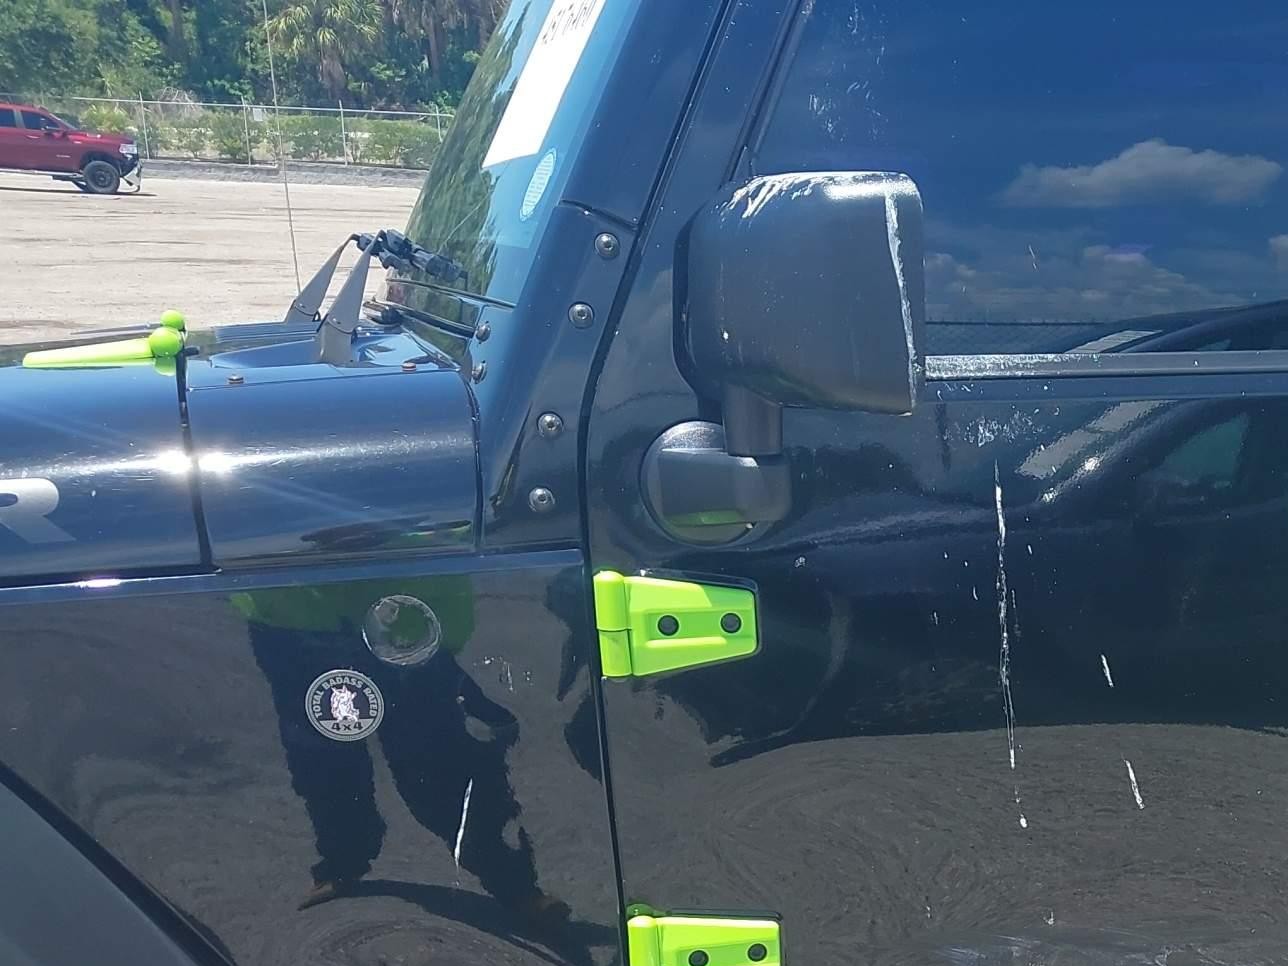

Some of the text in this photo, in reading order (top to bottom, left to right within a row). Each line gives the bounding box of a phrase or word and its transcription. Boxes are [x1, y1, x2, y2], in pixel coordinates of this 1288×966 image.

[313, 677, 378, 719] TOTAL BADASS RATED
